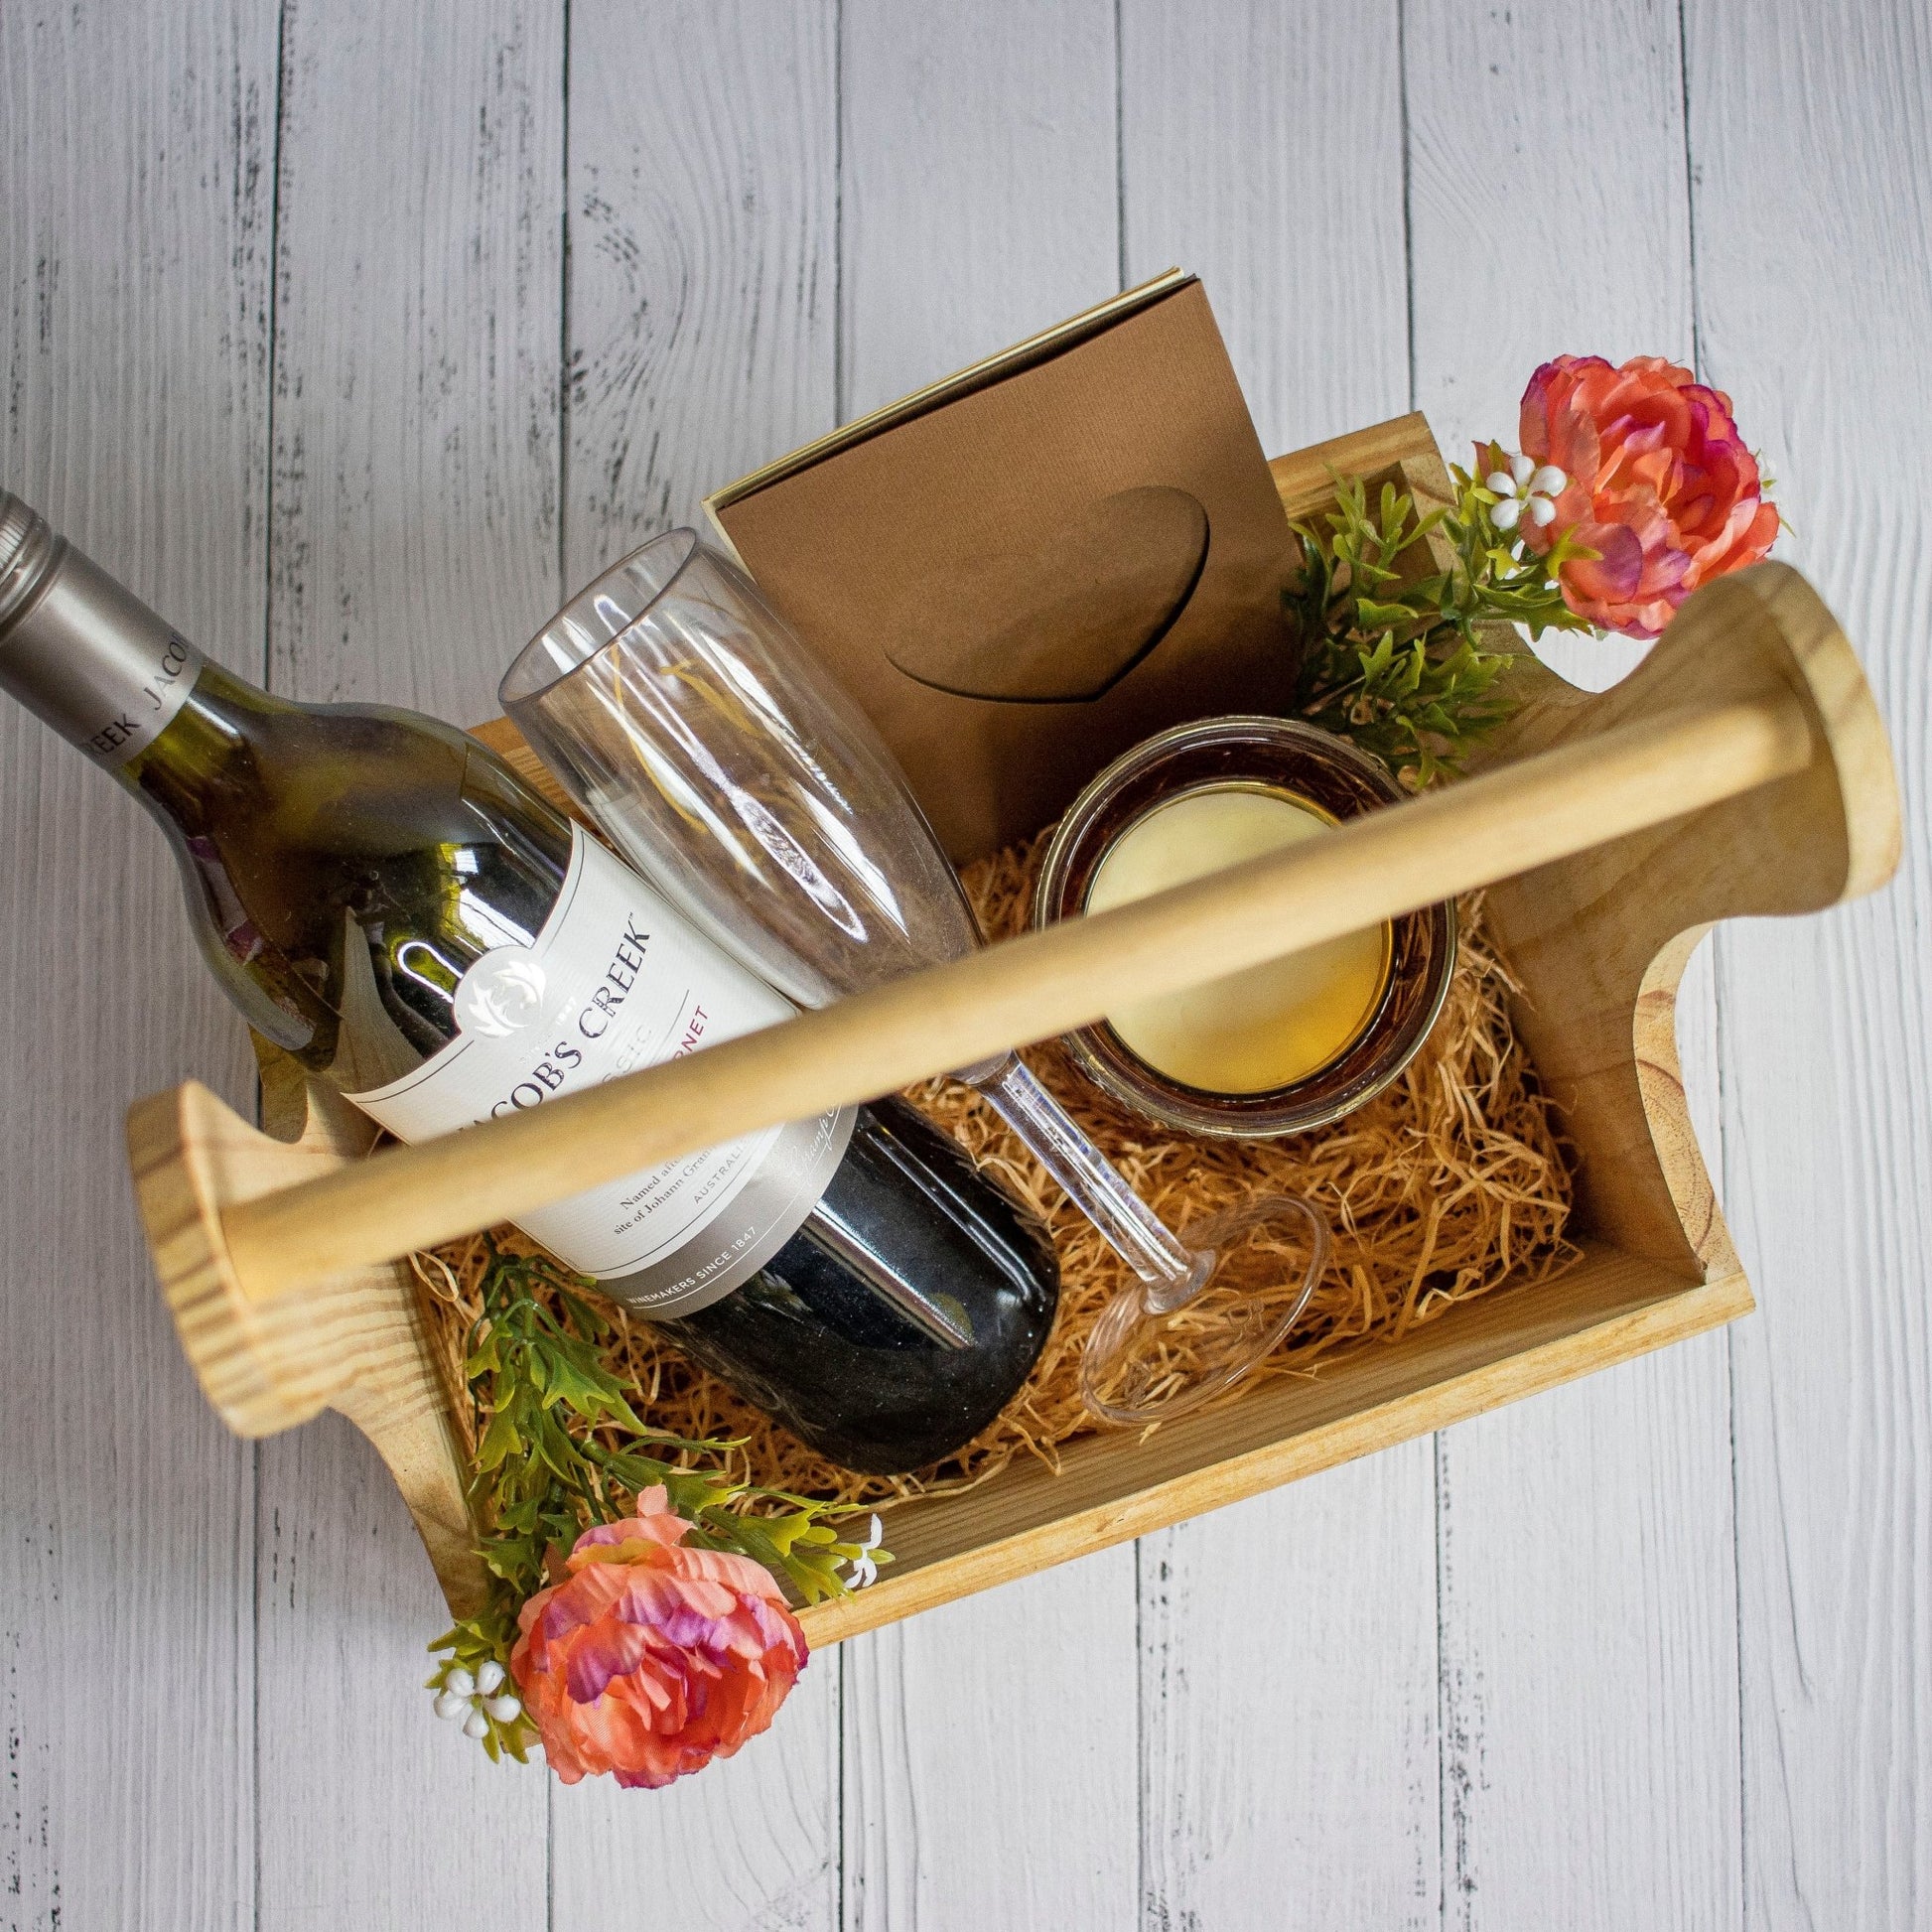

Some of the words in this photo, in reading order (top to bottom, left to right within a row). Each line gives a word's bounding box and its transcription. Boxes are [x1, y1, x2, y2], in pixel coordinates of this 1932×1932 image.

[614, 1221, 633, 1235] site
[633, 1209, 646, 1223] of
[644, 1178, 685, 1214] Johann
[620, 1175, 662, 1210] Named
[626, 1277, 696, 1305] WINEMAKERS
[696, 1251, 733, 1280] SINCE
[731, 1226, 757, 1251] 1847
